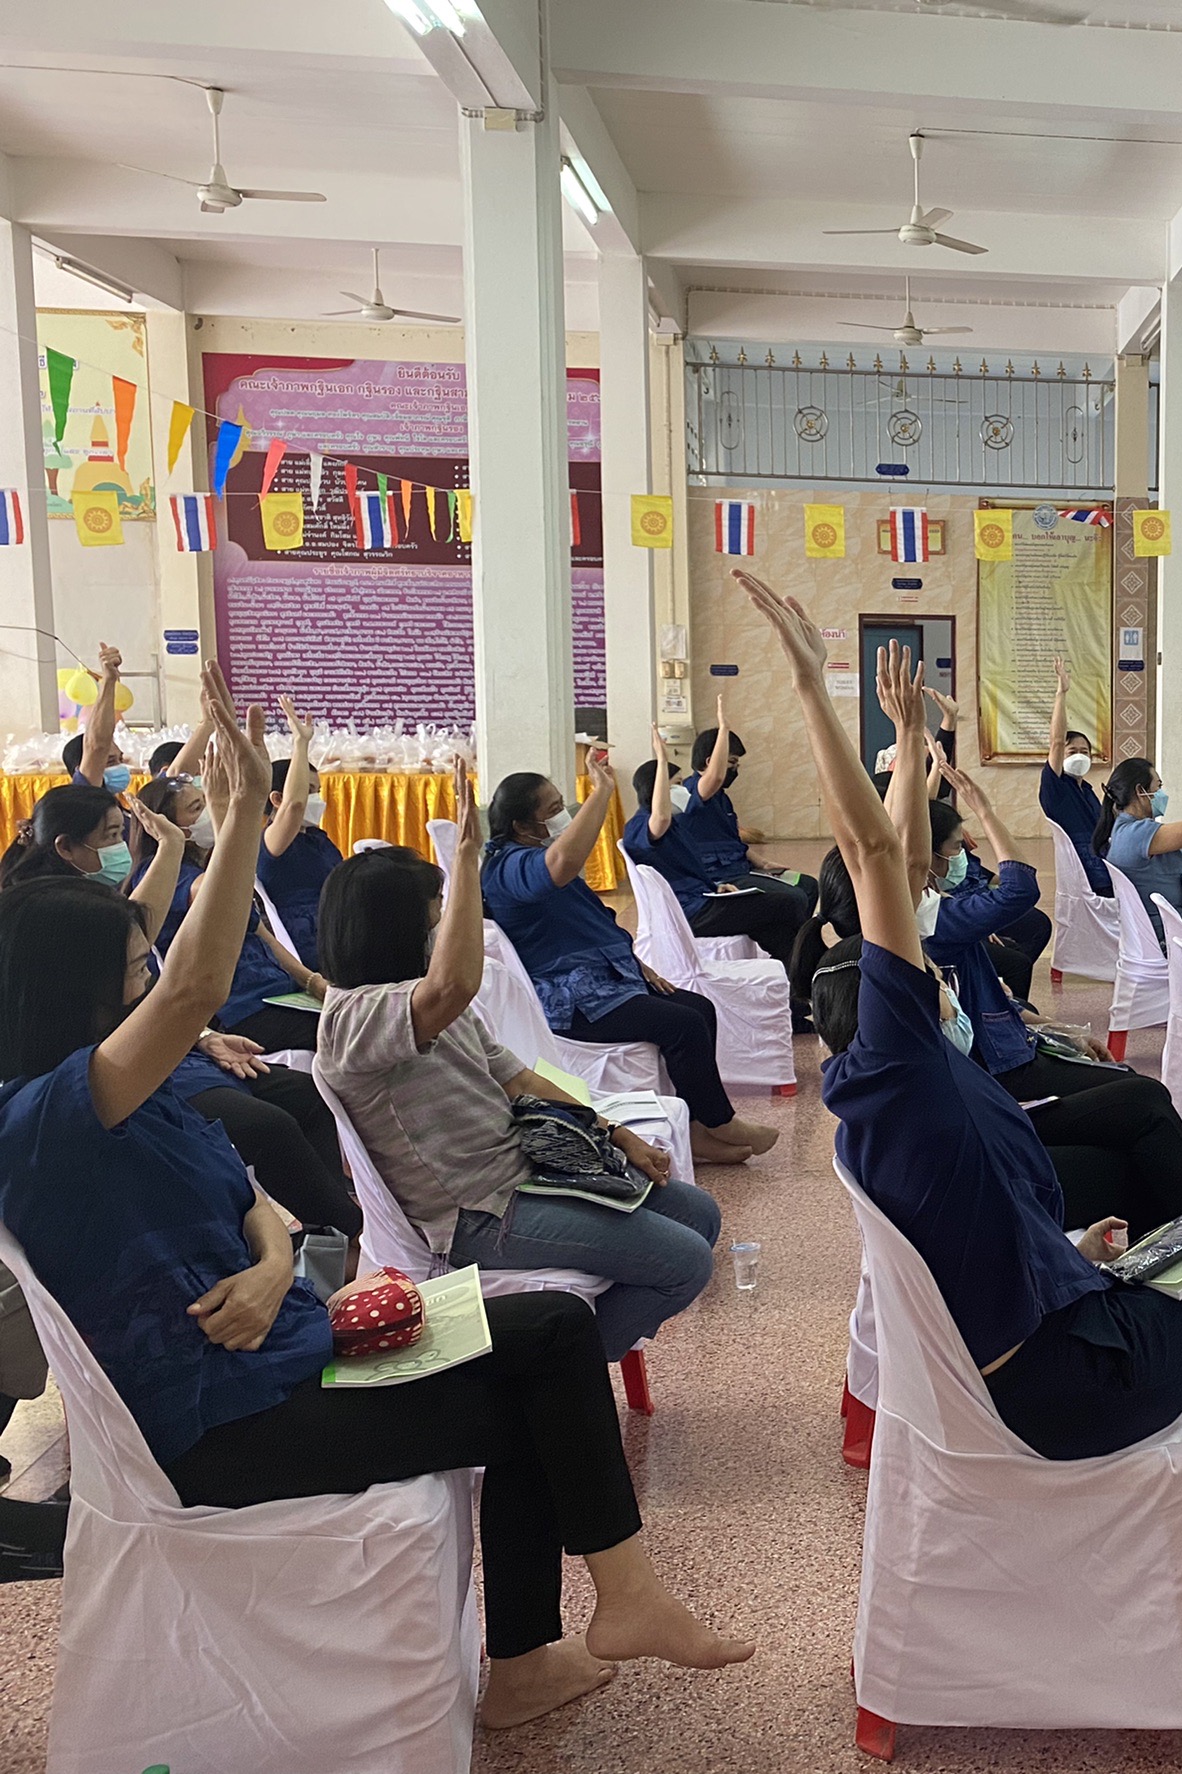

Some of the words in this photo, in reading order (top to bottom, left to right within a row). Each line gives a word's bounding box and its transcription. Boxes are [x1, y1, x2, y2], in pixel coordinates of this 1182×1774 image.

[397, 366, 460, 380] ยินดีต้อนรับ
[405, 385, 467, 400] และกฐินสา
[390, 401, 467, 413] คณะเจ้าภาพกฐินเอ
